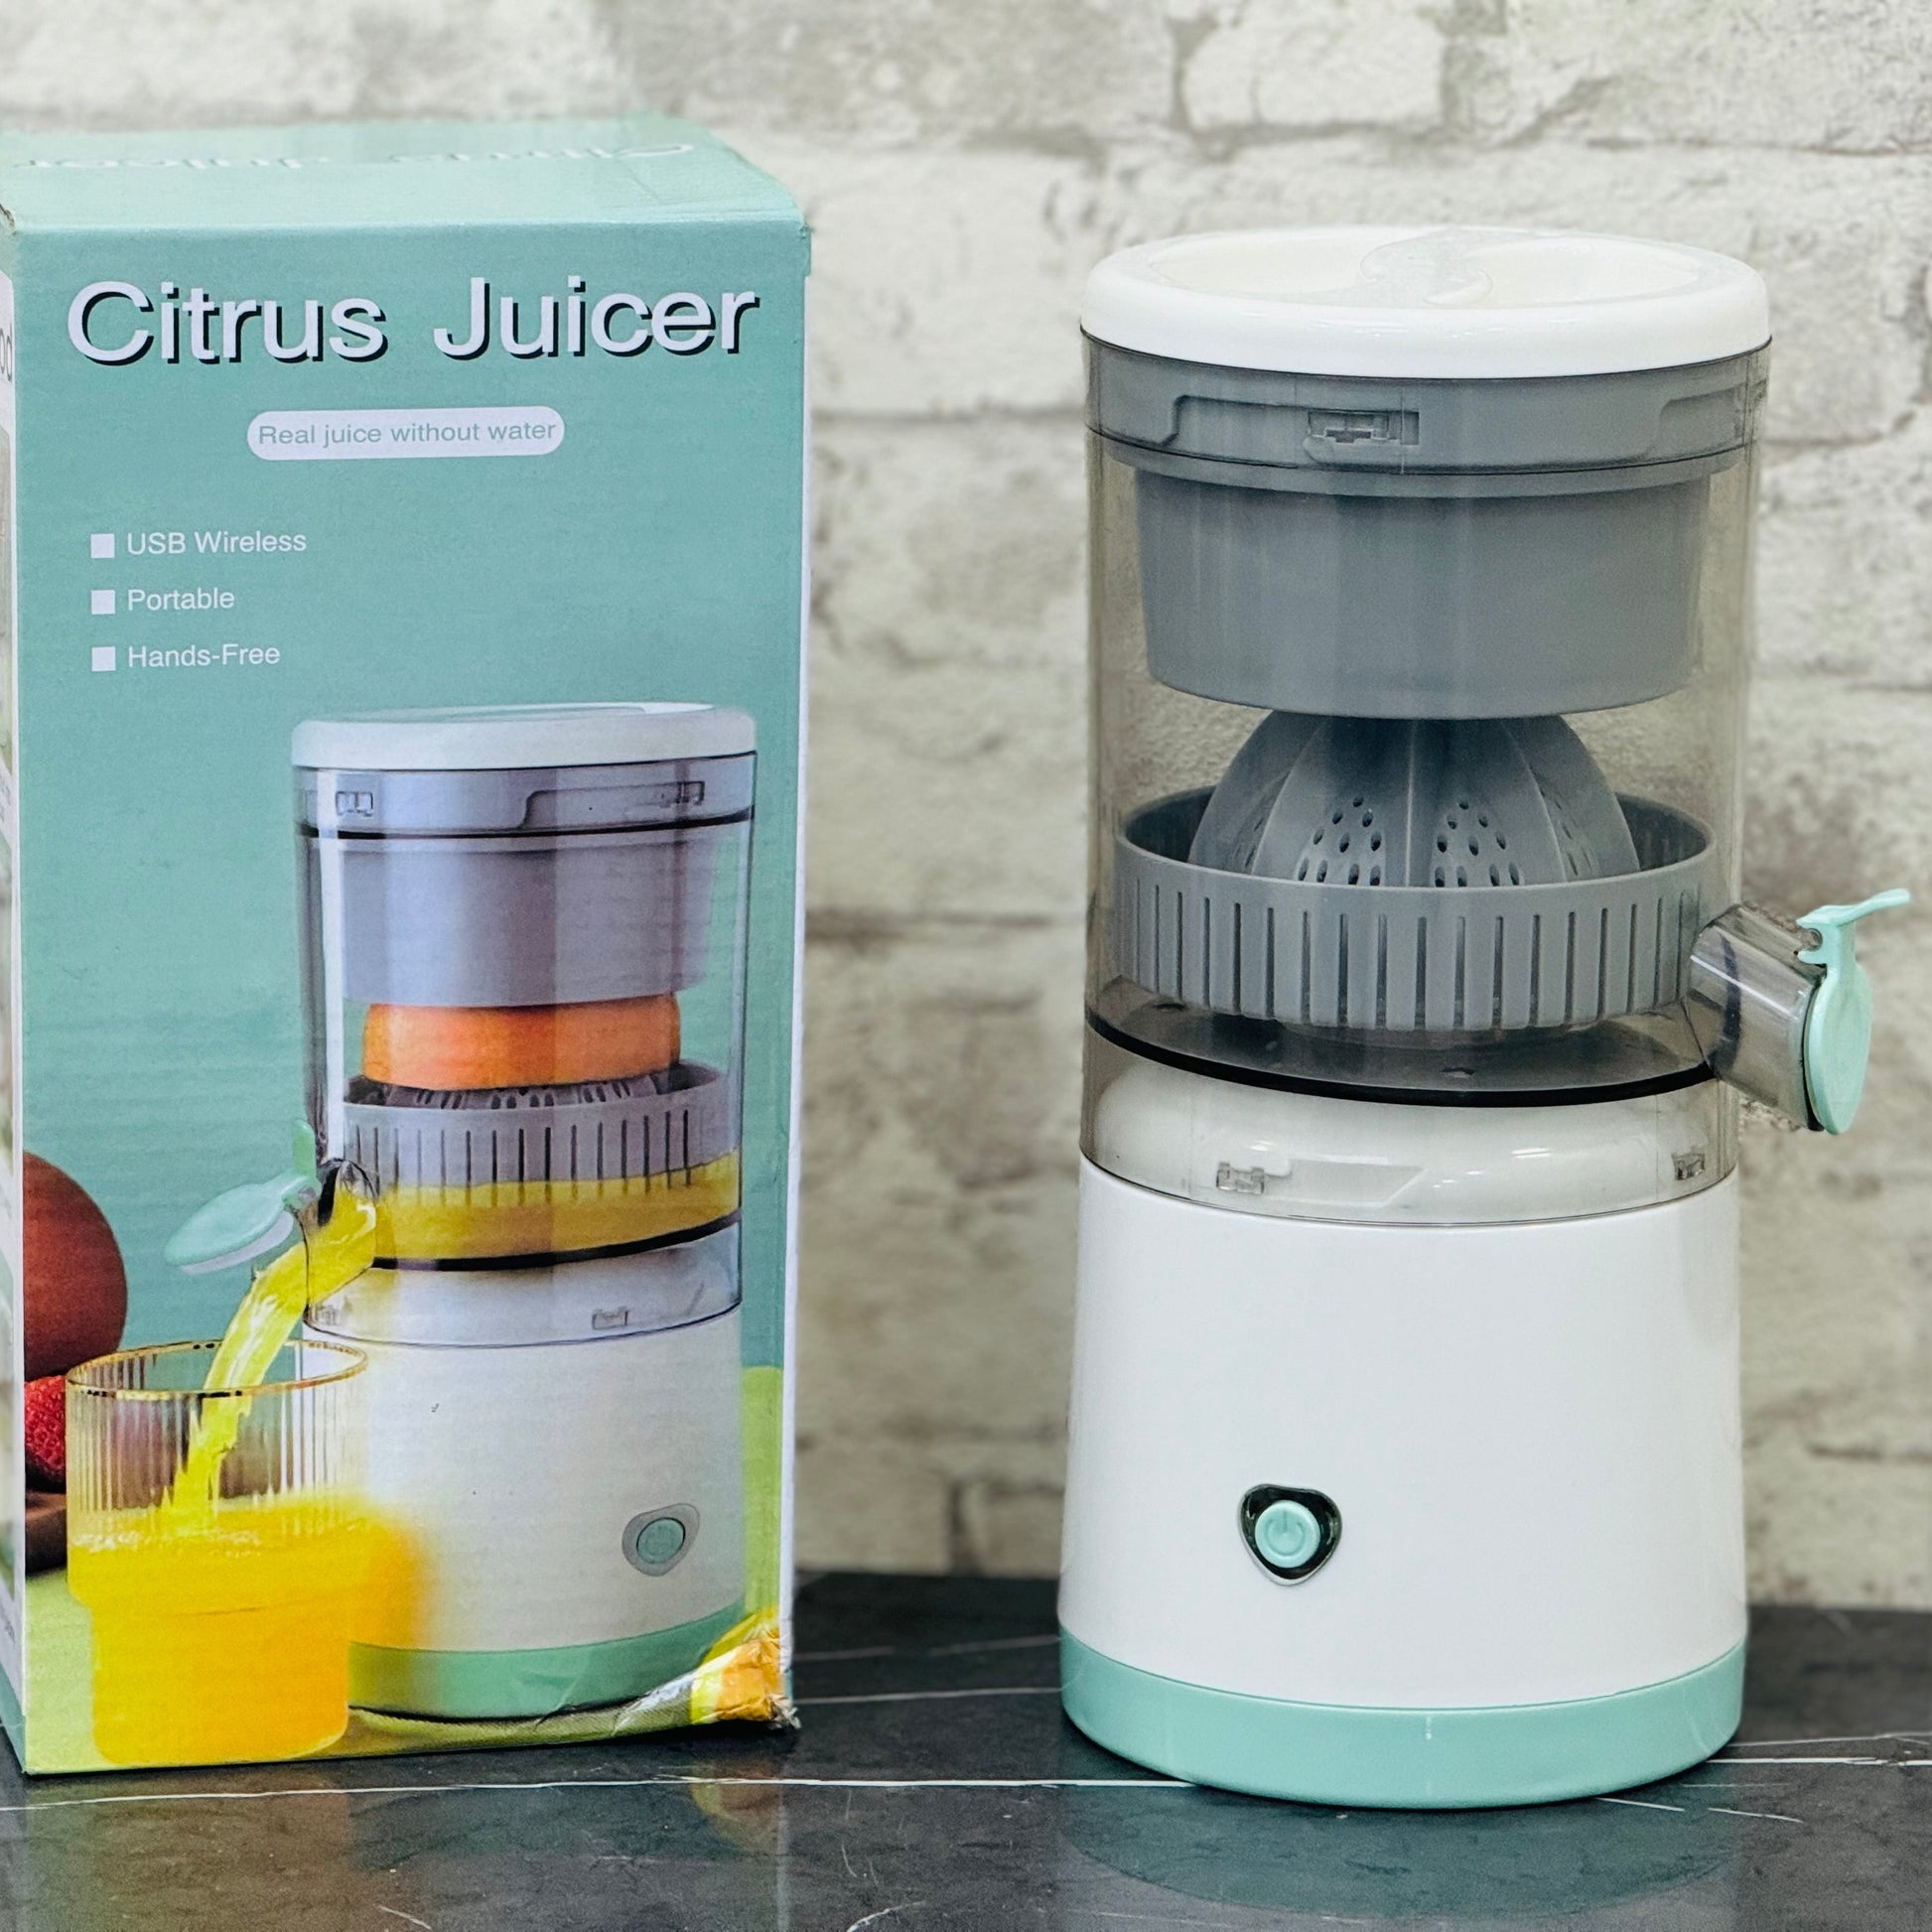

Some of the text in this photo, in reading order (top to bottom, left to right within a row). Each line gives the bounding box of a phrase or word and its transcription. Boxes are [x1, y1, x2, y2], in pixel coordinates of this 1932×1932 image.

[67, 275, 760, 366] Citrus Juicer
[258, 421, 557, 449] Real juice without water
[126, 530, 308, 556] USB Wireless
[127, 587, 235, 612] Portable
[127, 642, 281, 668] Hands-Free
